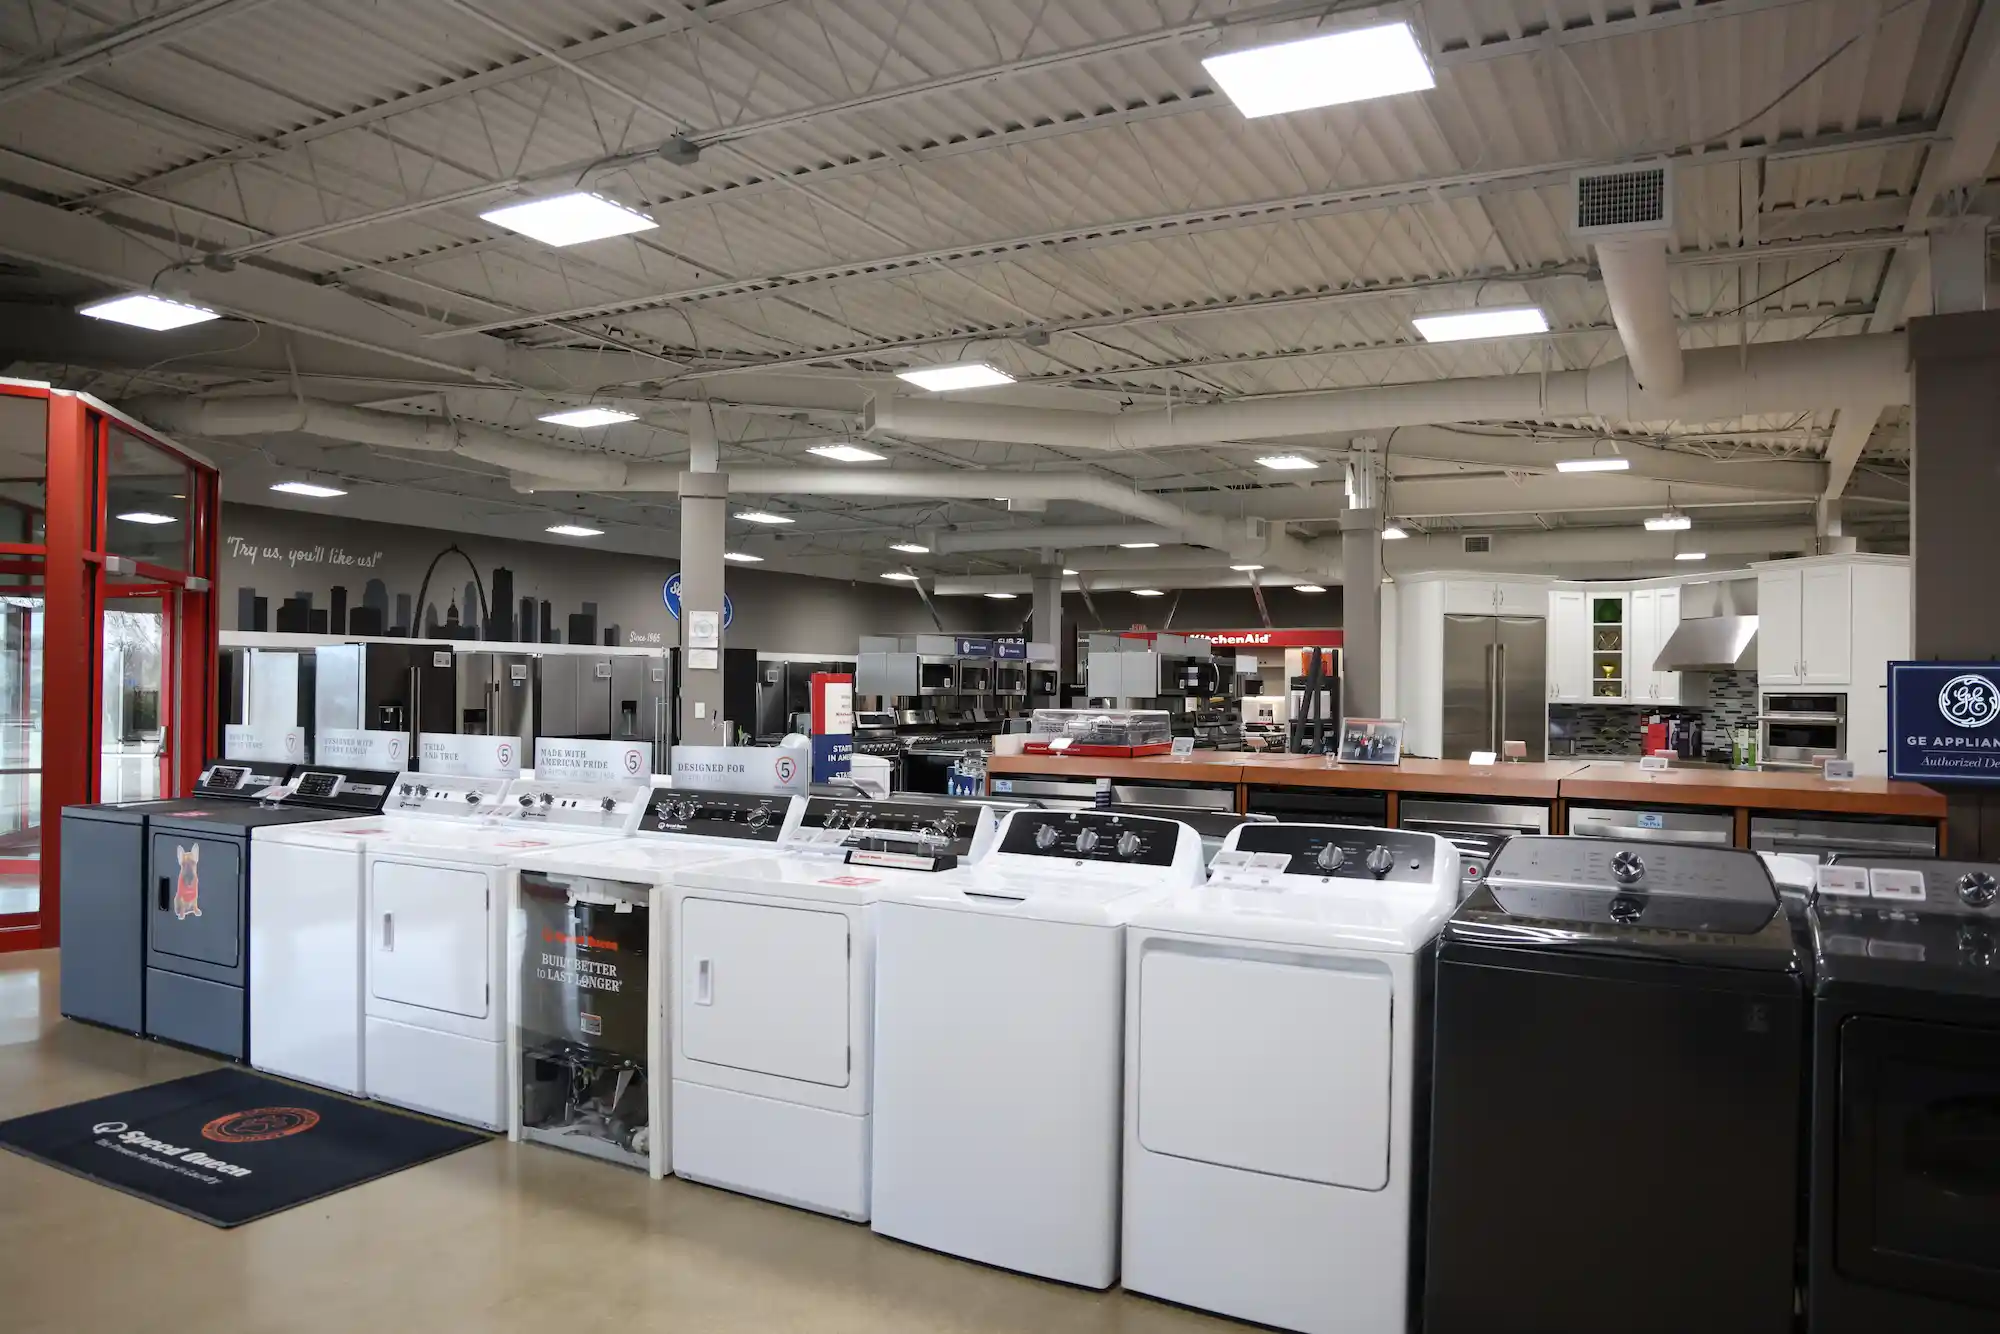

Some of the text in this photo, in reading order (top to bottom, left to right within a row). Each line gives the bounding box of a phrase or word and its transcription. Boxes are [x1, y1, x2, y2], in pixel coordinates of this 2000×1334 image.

[227, 536, 383, 568] "Try us, you'll like us!"
[629, 630, 646, 643] Since
[288, 737, 296, 749] 7
[424, 743, 445, 751] TRIED
[1906, 736, 2000, 748] GE APPLIAN
[391, 742, 399, 755] 7
[540, 748, 586, 758] MADE WITH
[424, 751, 459, 761] AND TRUE
[501, 748, 509, 762] 5
[828, 754, 837, 762] IN
[540, 757, 609, 769] AMERICAN PRIDE
[629, 755, 637, 770] 5
[1920, 756, 1981, 767] Authorized
[678, 763, 745, 773] DESIGNED FOR
[781, 762, 790, 778] 5
[574, 959, 617, 977] BETTER
[537, 967, 620, 992] to LAST LONGER
[118, 1131, 252, 1177] Speed Queen
